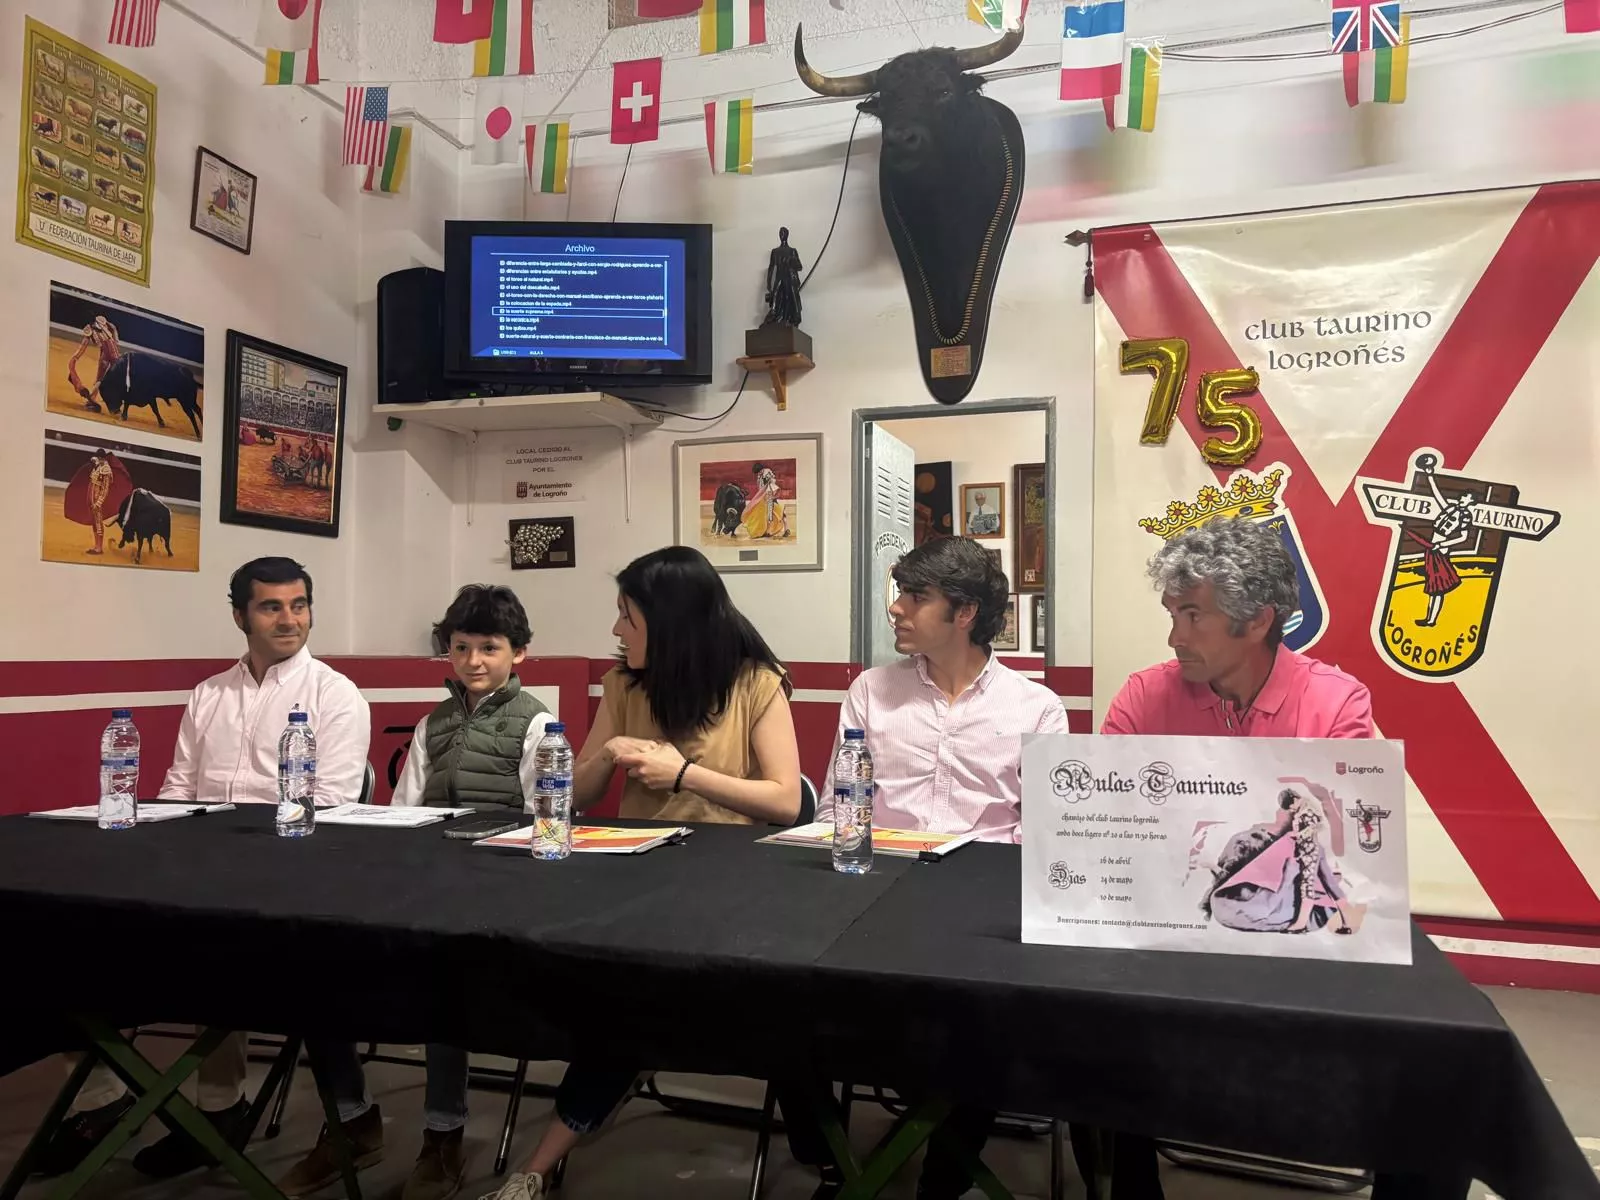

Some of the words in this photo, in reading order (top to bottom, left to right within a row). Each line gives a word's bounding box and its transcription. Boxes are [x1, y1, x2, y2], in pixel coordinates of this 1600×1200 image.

[48, 223, 88, 247] FEDERACIÓN
[88, 237, 113, 256] TAURINA
[121, 249, 137, 265] JAÉN
[565, 244, 595, 253] Archivo
[538, 446, 562, 454] CEDIDO
[529, 482, 572, 491] Ayuntamiento
[542, 490, 568, 498] Logroño
[1375, 493, 1432, 515] CLUB
[1473, 507, 1544, 533] TAURINO
[1387, 610, 1478, 666] LOGROÑÉS
[1348, 765, 1384, 775] Logroño
[1138, 761, 1248, 805] Taurinas
[1086, 814, 1095, 822] del
[1095, 814, 1108, 822] club
[1109, 815, 1132, 823] taurino
[1108, 856, 1114, 864] de
[1115, 856, 1132, 865] abril
[1048, 861, 1087, 889] Días
[1108, 875, 1115, 884] de
[1115, 877, 1133, 885] mayo
[1108, 893, 1114, 901] de
[1057, 916, 1100, 925] Inscripciones:
